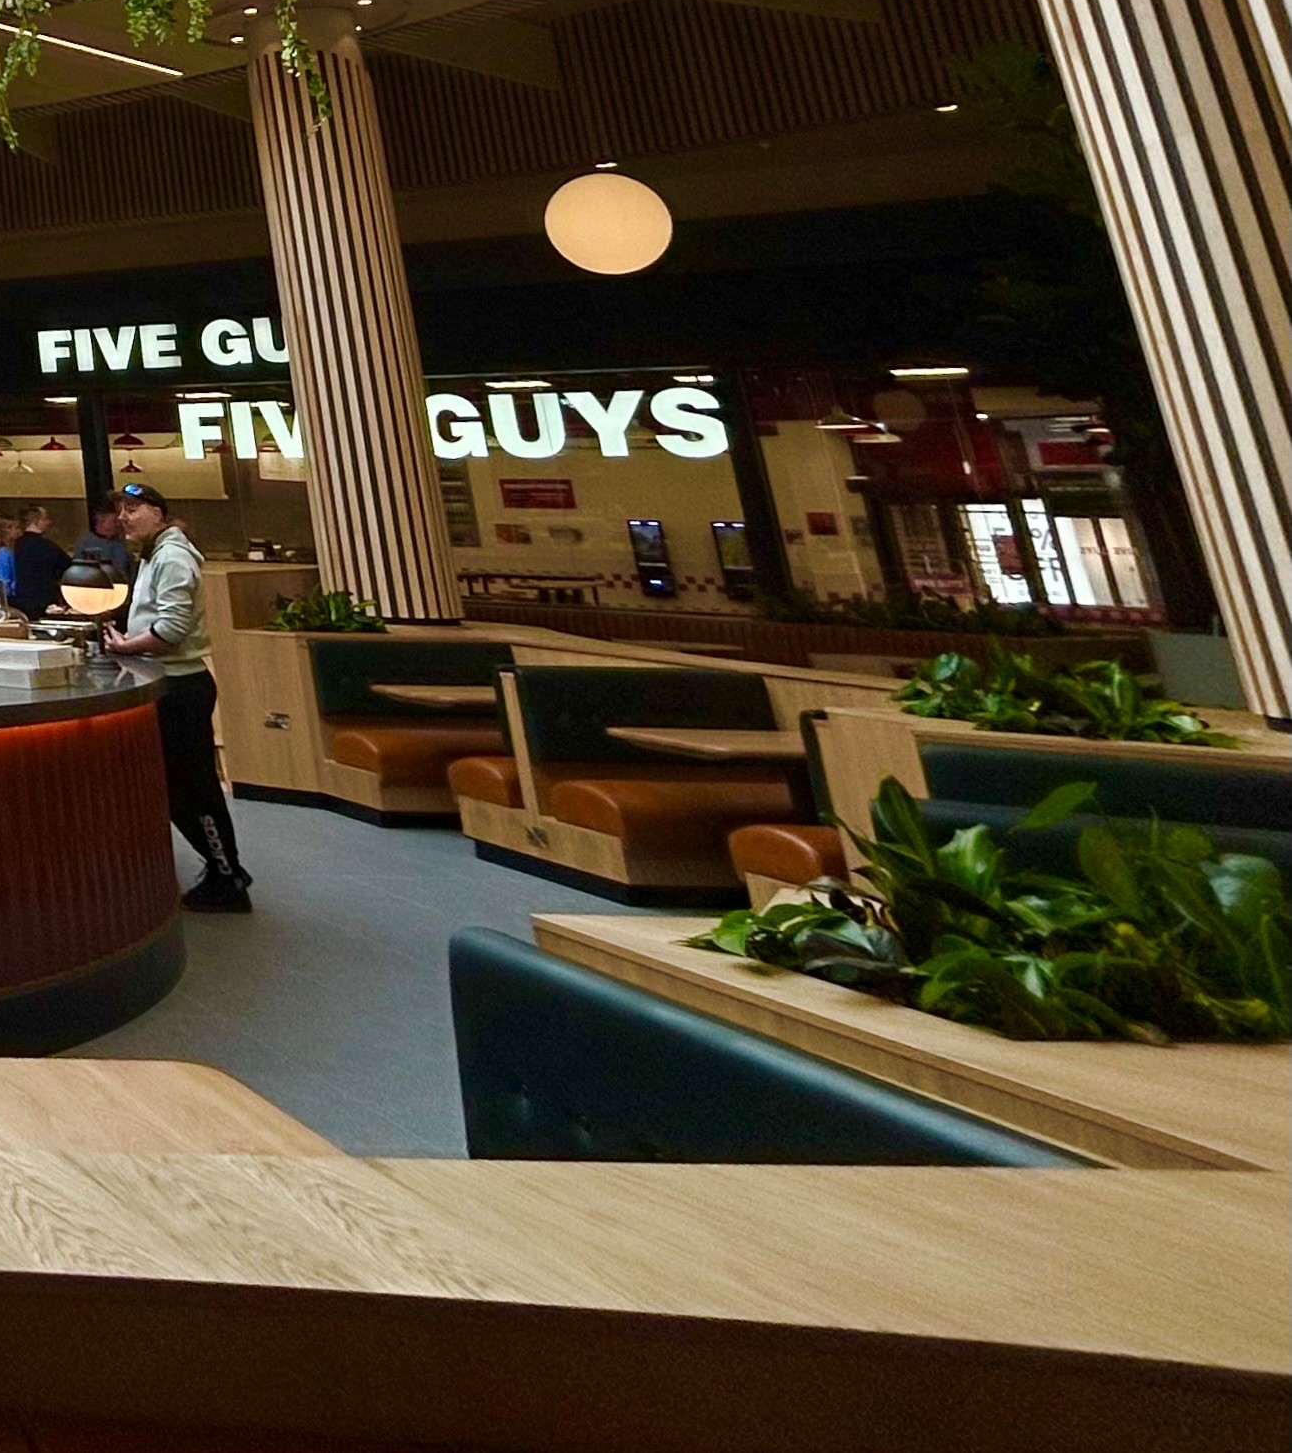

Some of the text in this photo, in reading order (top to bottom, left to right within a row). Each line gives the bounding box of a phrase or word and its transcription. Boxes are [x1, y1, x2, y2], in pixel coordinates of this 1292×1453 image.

[37, 317, 289, 373] FIVE GU
[178, 386, 729, 461] FIV GUYS
